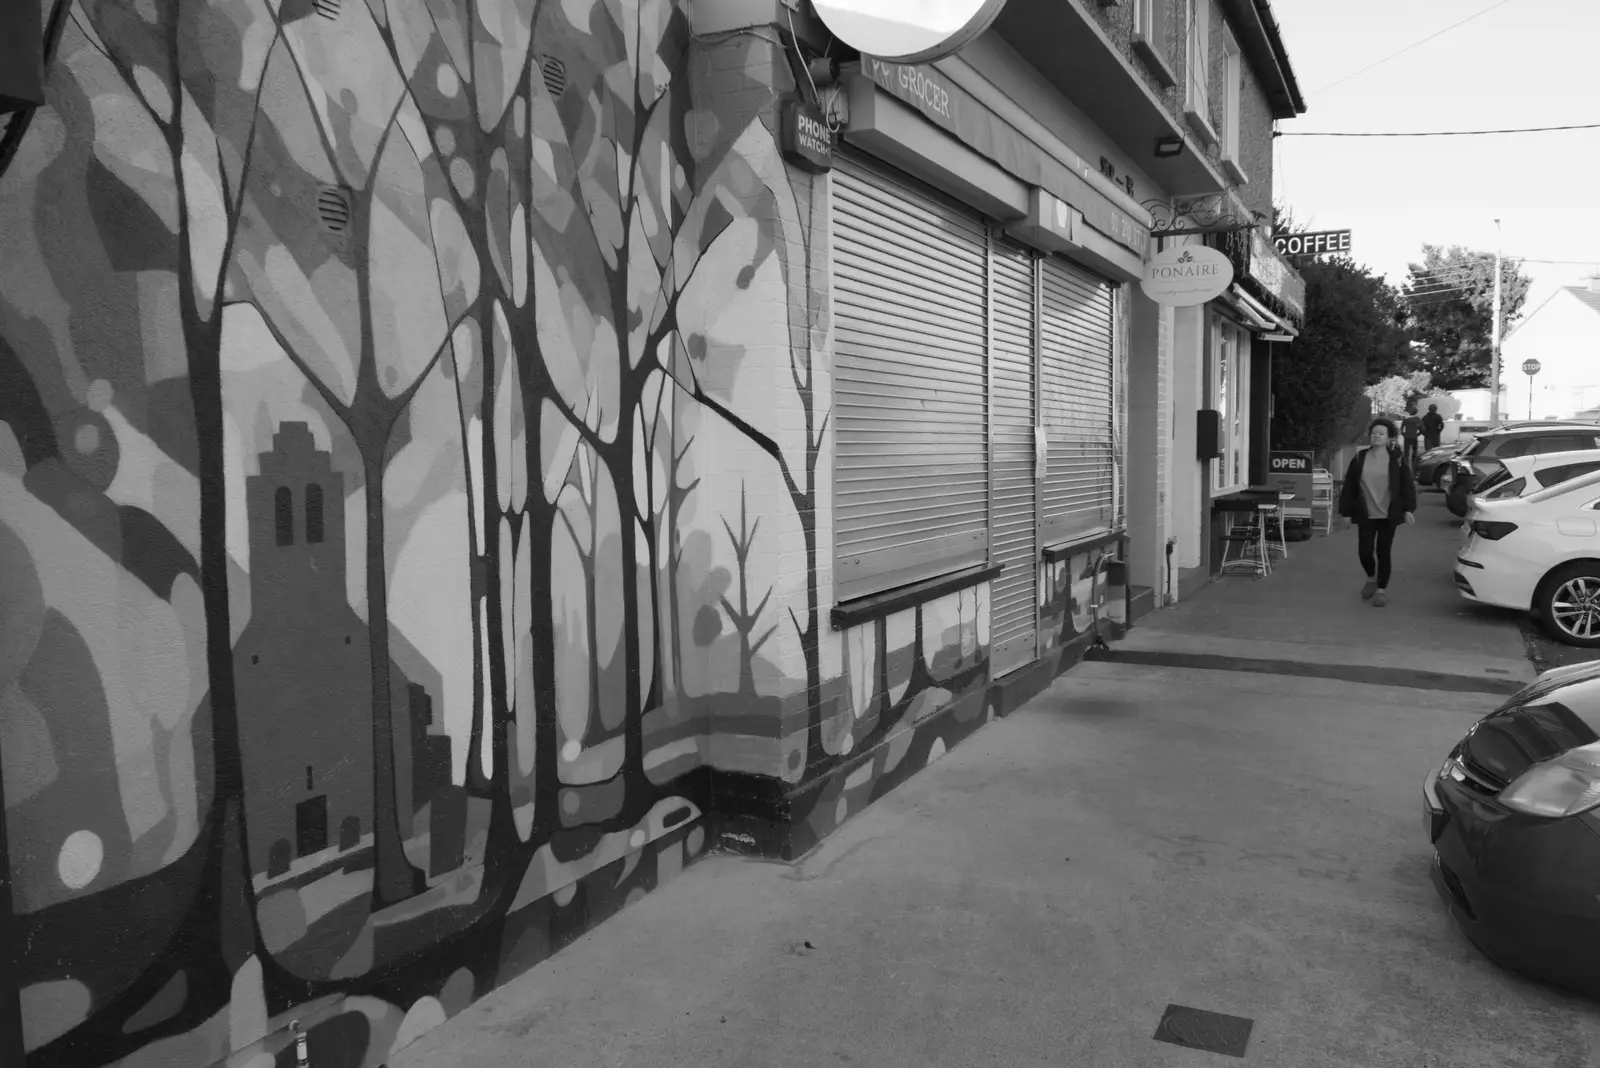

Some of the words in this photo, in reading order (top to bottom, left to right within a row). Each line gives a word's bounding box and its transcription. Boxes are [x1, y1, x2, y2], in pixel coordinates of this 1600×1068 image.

[898, 65, 950, 118] GROCER
[798, 114, 831, 144] PHONE
[798, 132, 826, 155] WATCH
[1275, 232, 1350, 255] COFFEE
[1151, 263, 1219, 279] PONAIRE
[1522, 363, 1541, 371] STOP
[1272, 458, 1306, 469] OPEN
